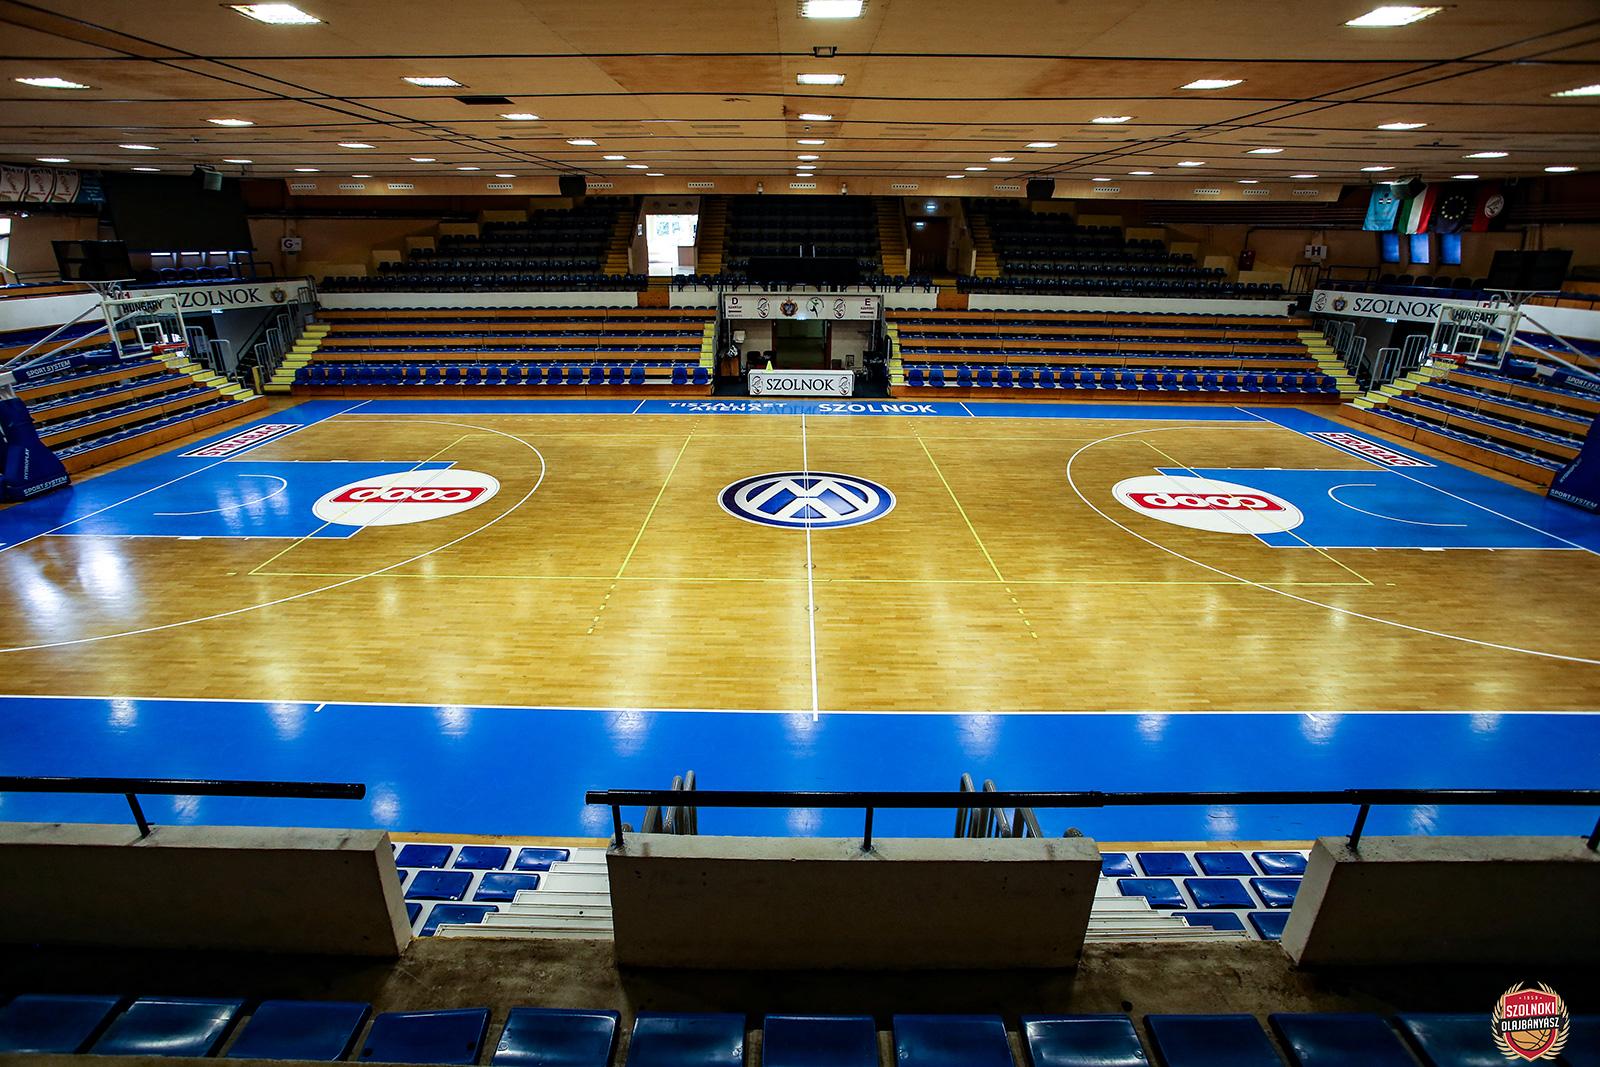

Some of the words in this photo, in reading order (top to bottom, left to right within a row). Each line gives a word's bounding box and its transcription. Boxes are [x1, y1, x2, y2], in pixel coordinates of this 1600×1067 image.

[283, 239, 294, 248] G
[1311, 246, 1321, 256] H
[731, 297, 739, 305] D
[865, 298, 871, 306] E
[121, 299, 165, 314] HUNGARY
[1353, 297, 1442, 318] SZOLNOK
[1454, 310, 1499, 326] HUNGARY
[766, 379, 834, 391] SZOLNOK
[818, 403, 937, 413] SZOLNOK
